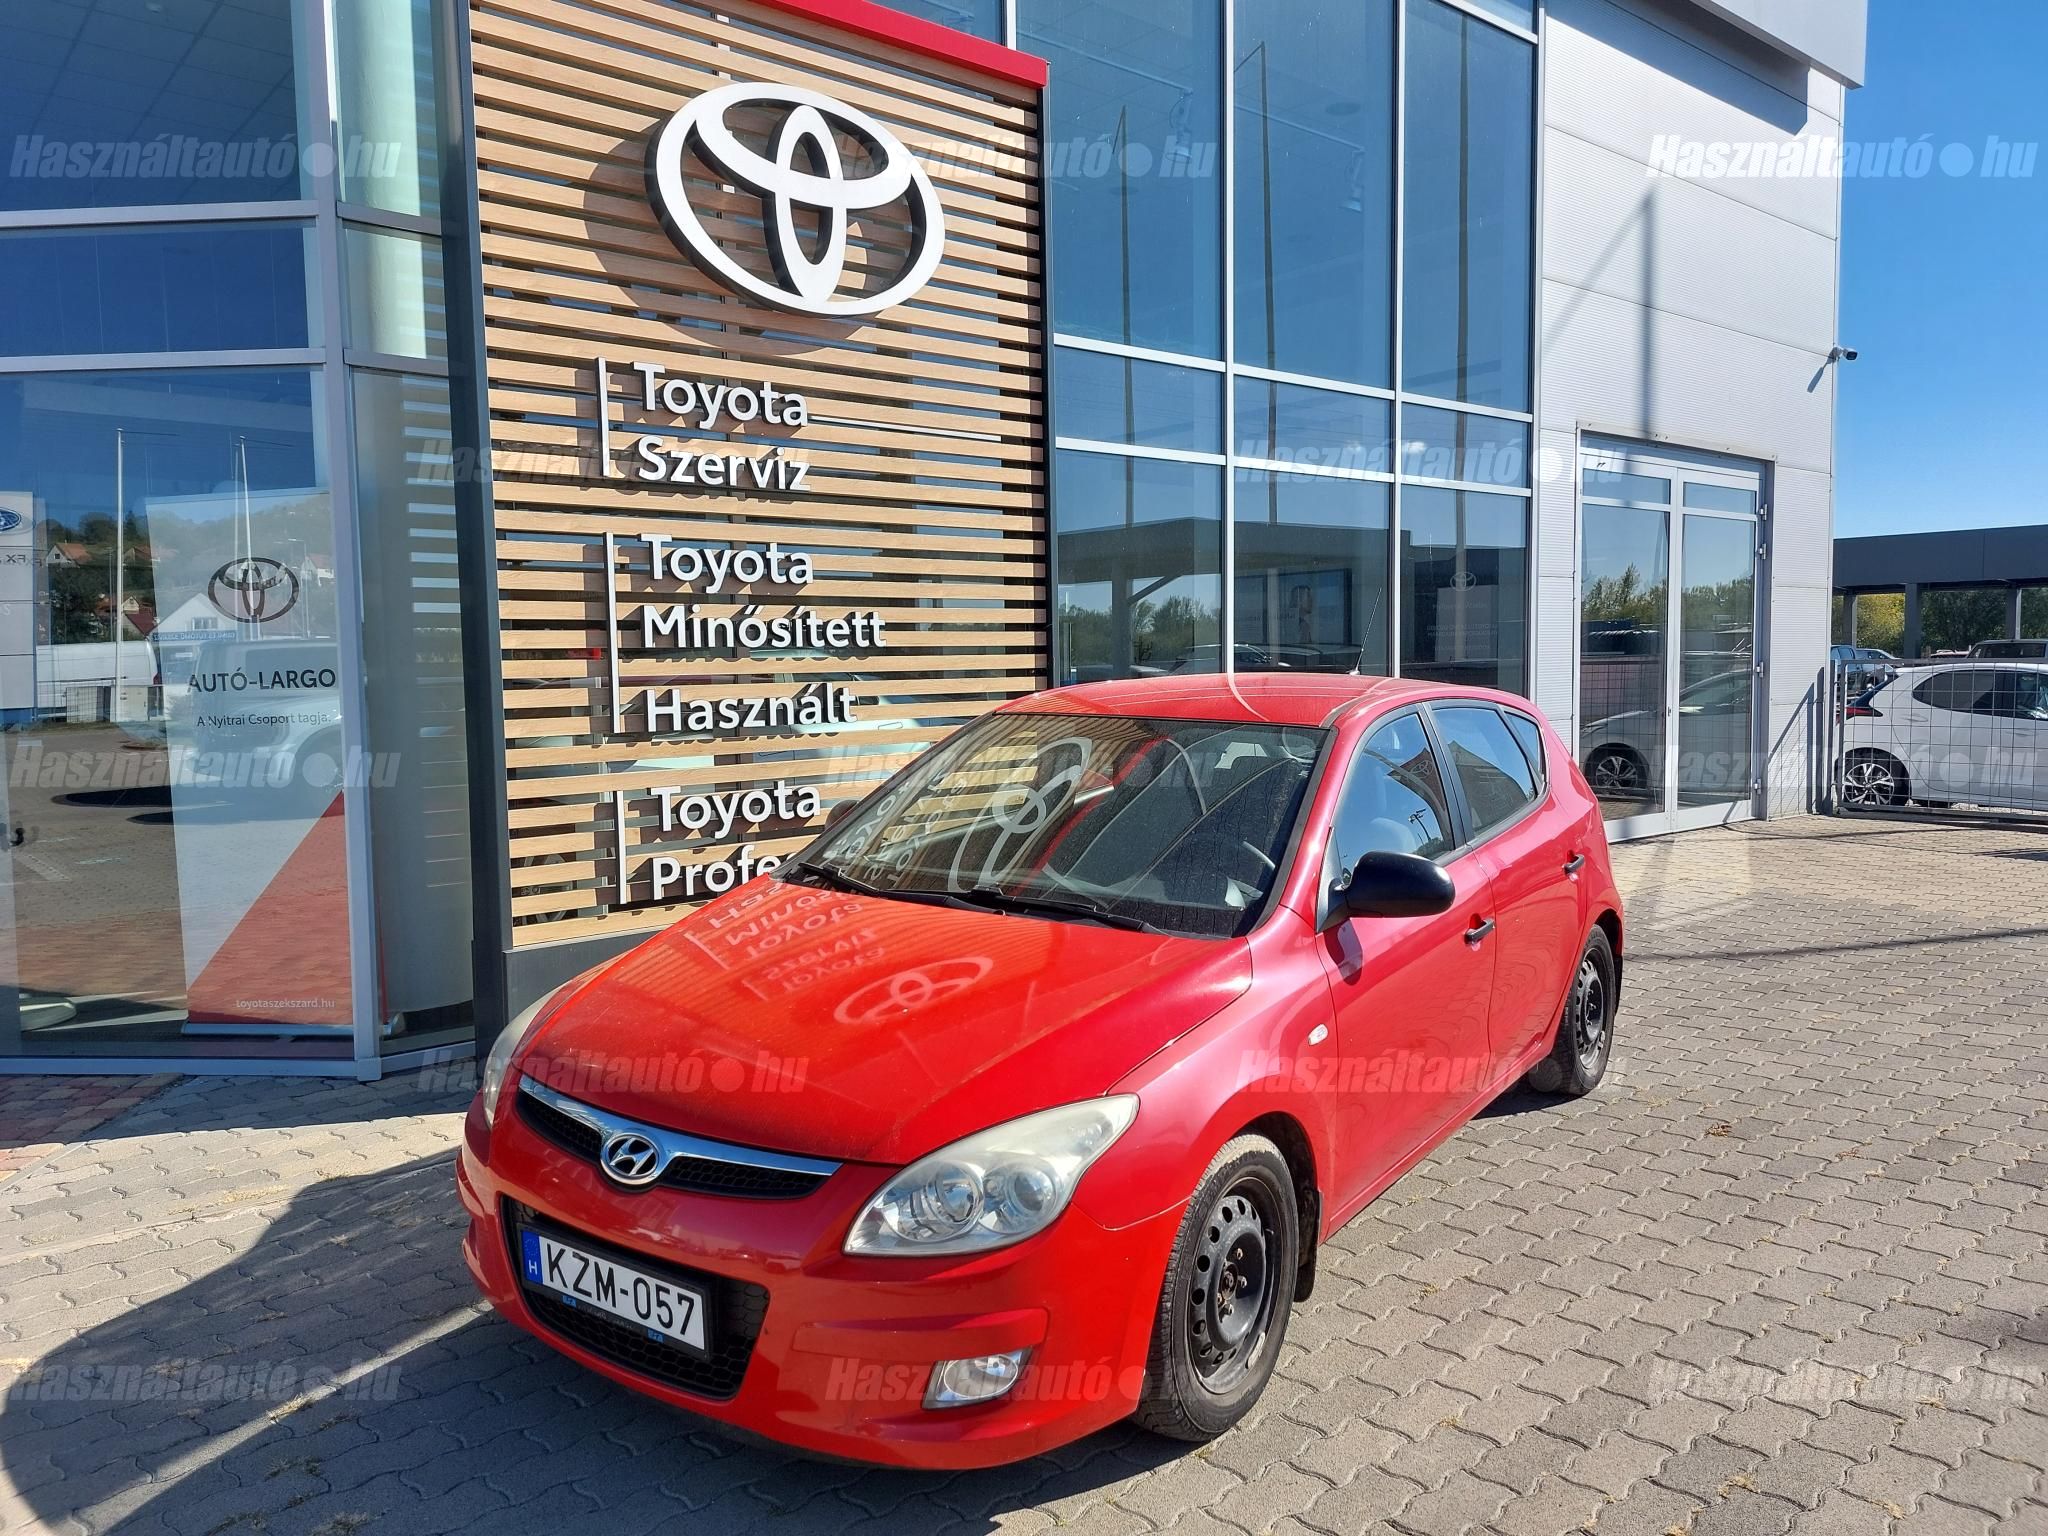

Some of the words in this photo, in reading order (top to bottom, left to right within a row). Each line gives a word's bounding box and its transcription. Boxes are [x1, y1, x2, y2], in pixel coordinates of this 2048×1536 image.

[633, 361, 809, 428] Toyota
[637, 436, 812, 491] Szerviz
[640, 533, 814, 594] Toyota
[643, 604, 887, 648] Minősített
[187, 667, 336, 693] AUTÓ-LARGO
[197, 716, 205, 727] A
[208, 713, 245, 728] Nyitrai
[248, 713, 295, 727] Csoport
[646, 683, 858, 733] Használt
[651, 780, 821, 839] Toyota
[653, 845, 796, 900] Profe
[528, 1259, 538, 1276] H
[547, 1243, 695, 1336] KZM-057
